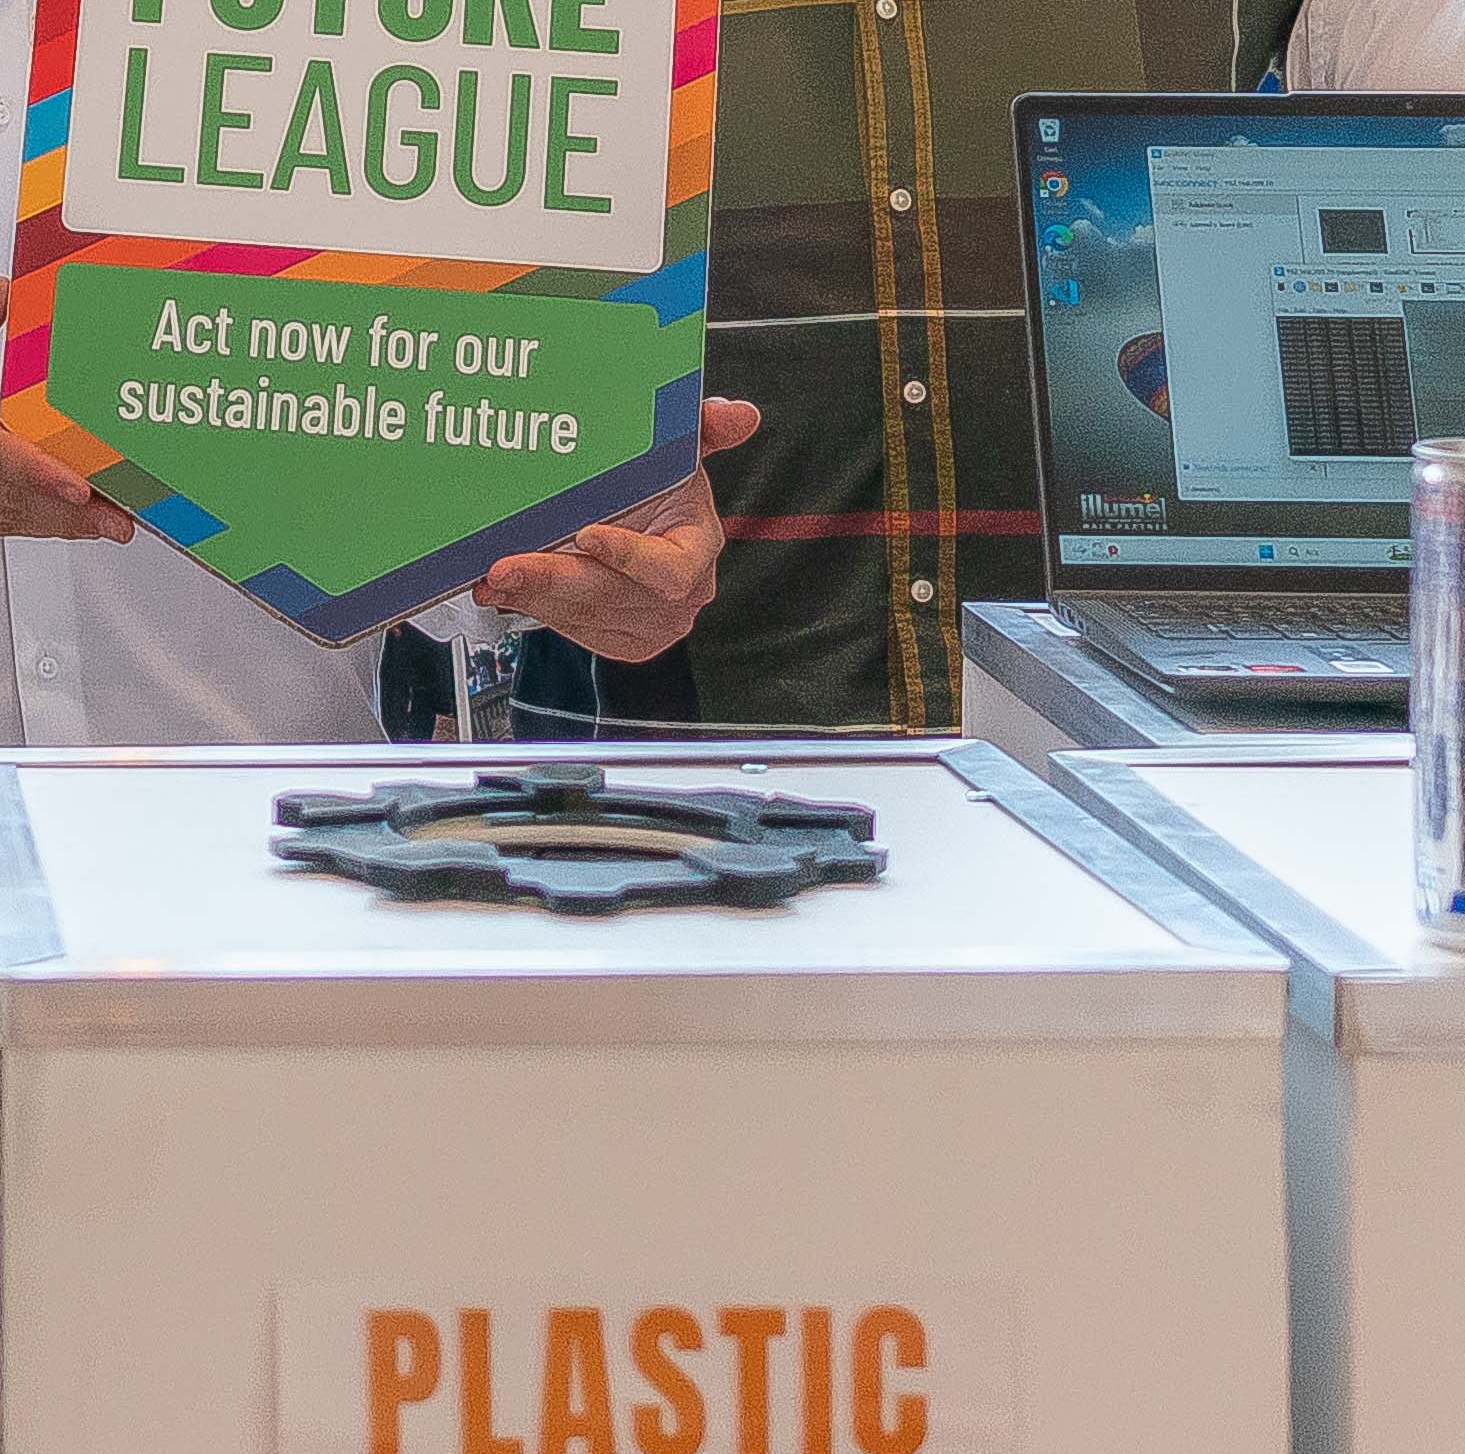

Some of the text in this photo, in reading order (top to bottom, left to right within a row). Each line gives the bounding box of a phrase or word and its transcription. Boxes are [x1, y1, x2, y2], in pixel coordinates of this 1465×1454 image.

[118, 47, 619, 215] LEAGUE
[153, 301, 539, 379] Act now for our
[118, 378, 579, 454] sustainable future
